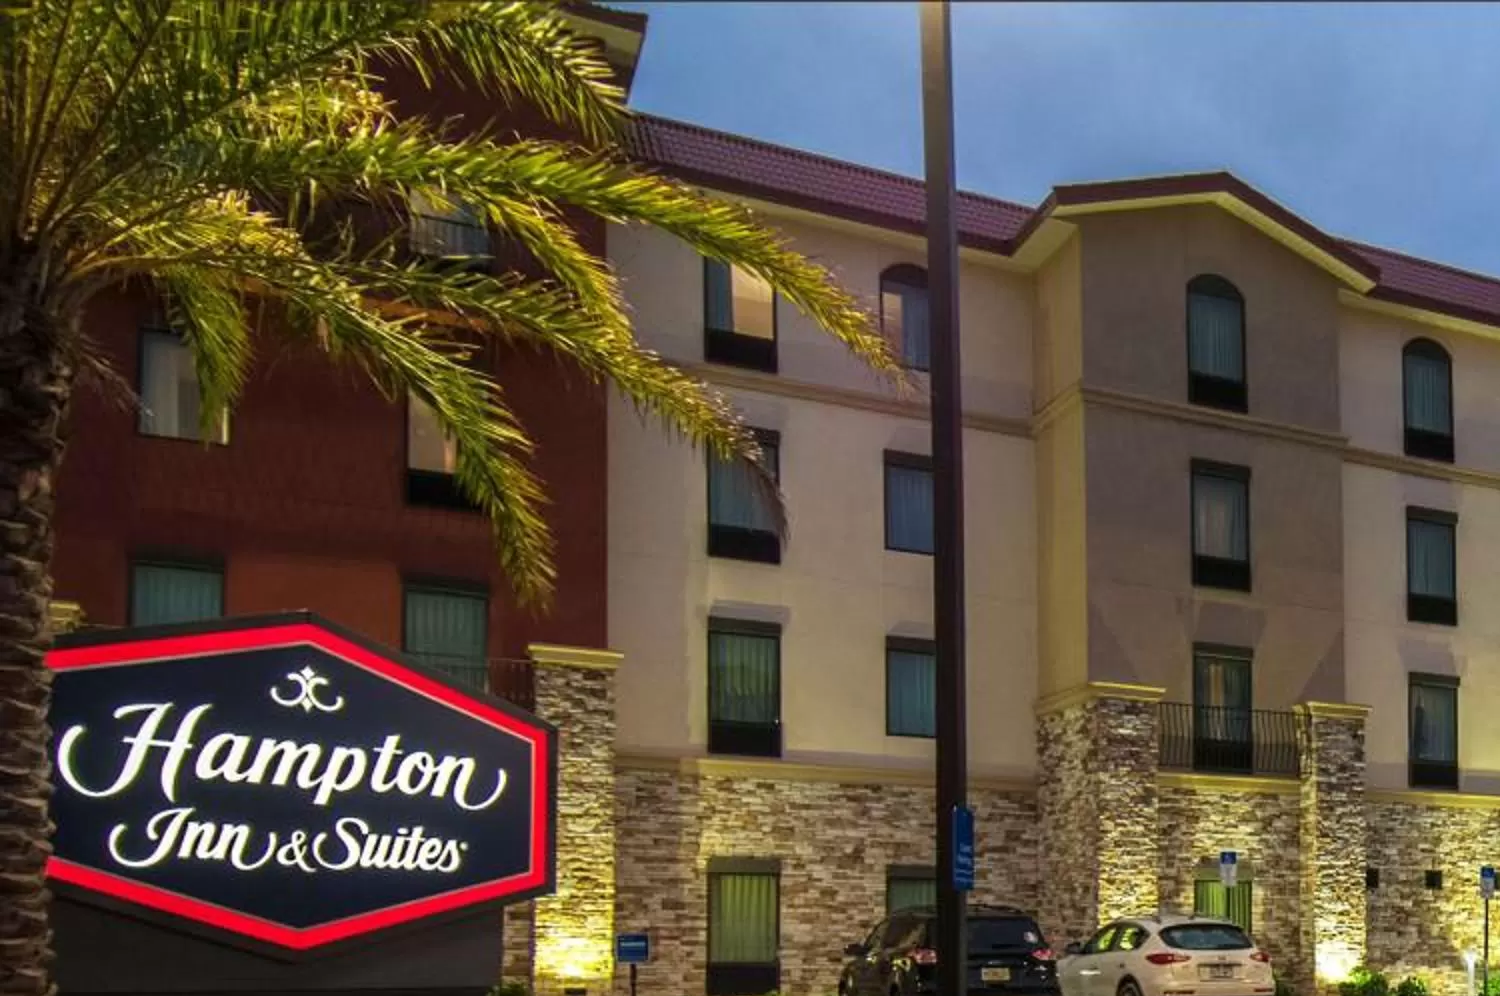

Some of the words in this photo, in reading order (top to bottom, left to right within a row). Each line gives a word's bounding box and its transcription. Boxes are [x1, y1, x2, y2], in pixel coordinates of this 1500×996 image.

[57, 701, 507, 811] Hampton
[109, 807, 276, 871] Inn
[276, 830, 317, 873] &
[313, 817, 465, 873] Suites
